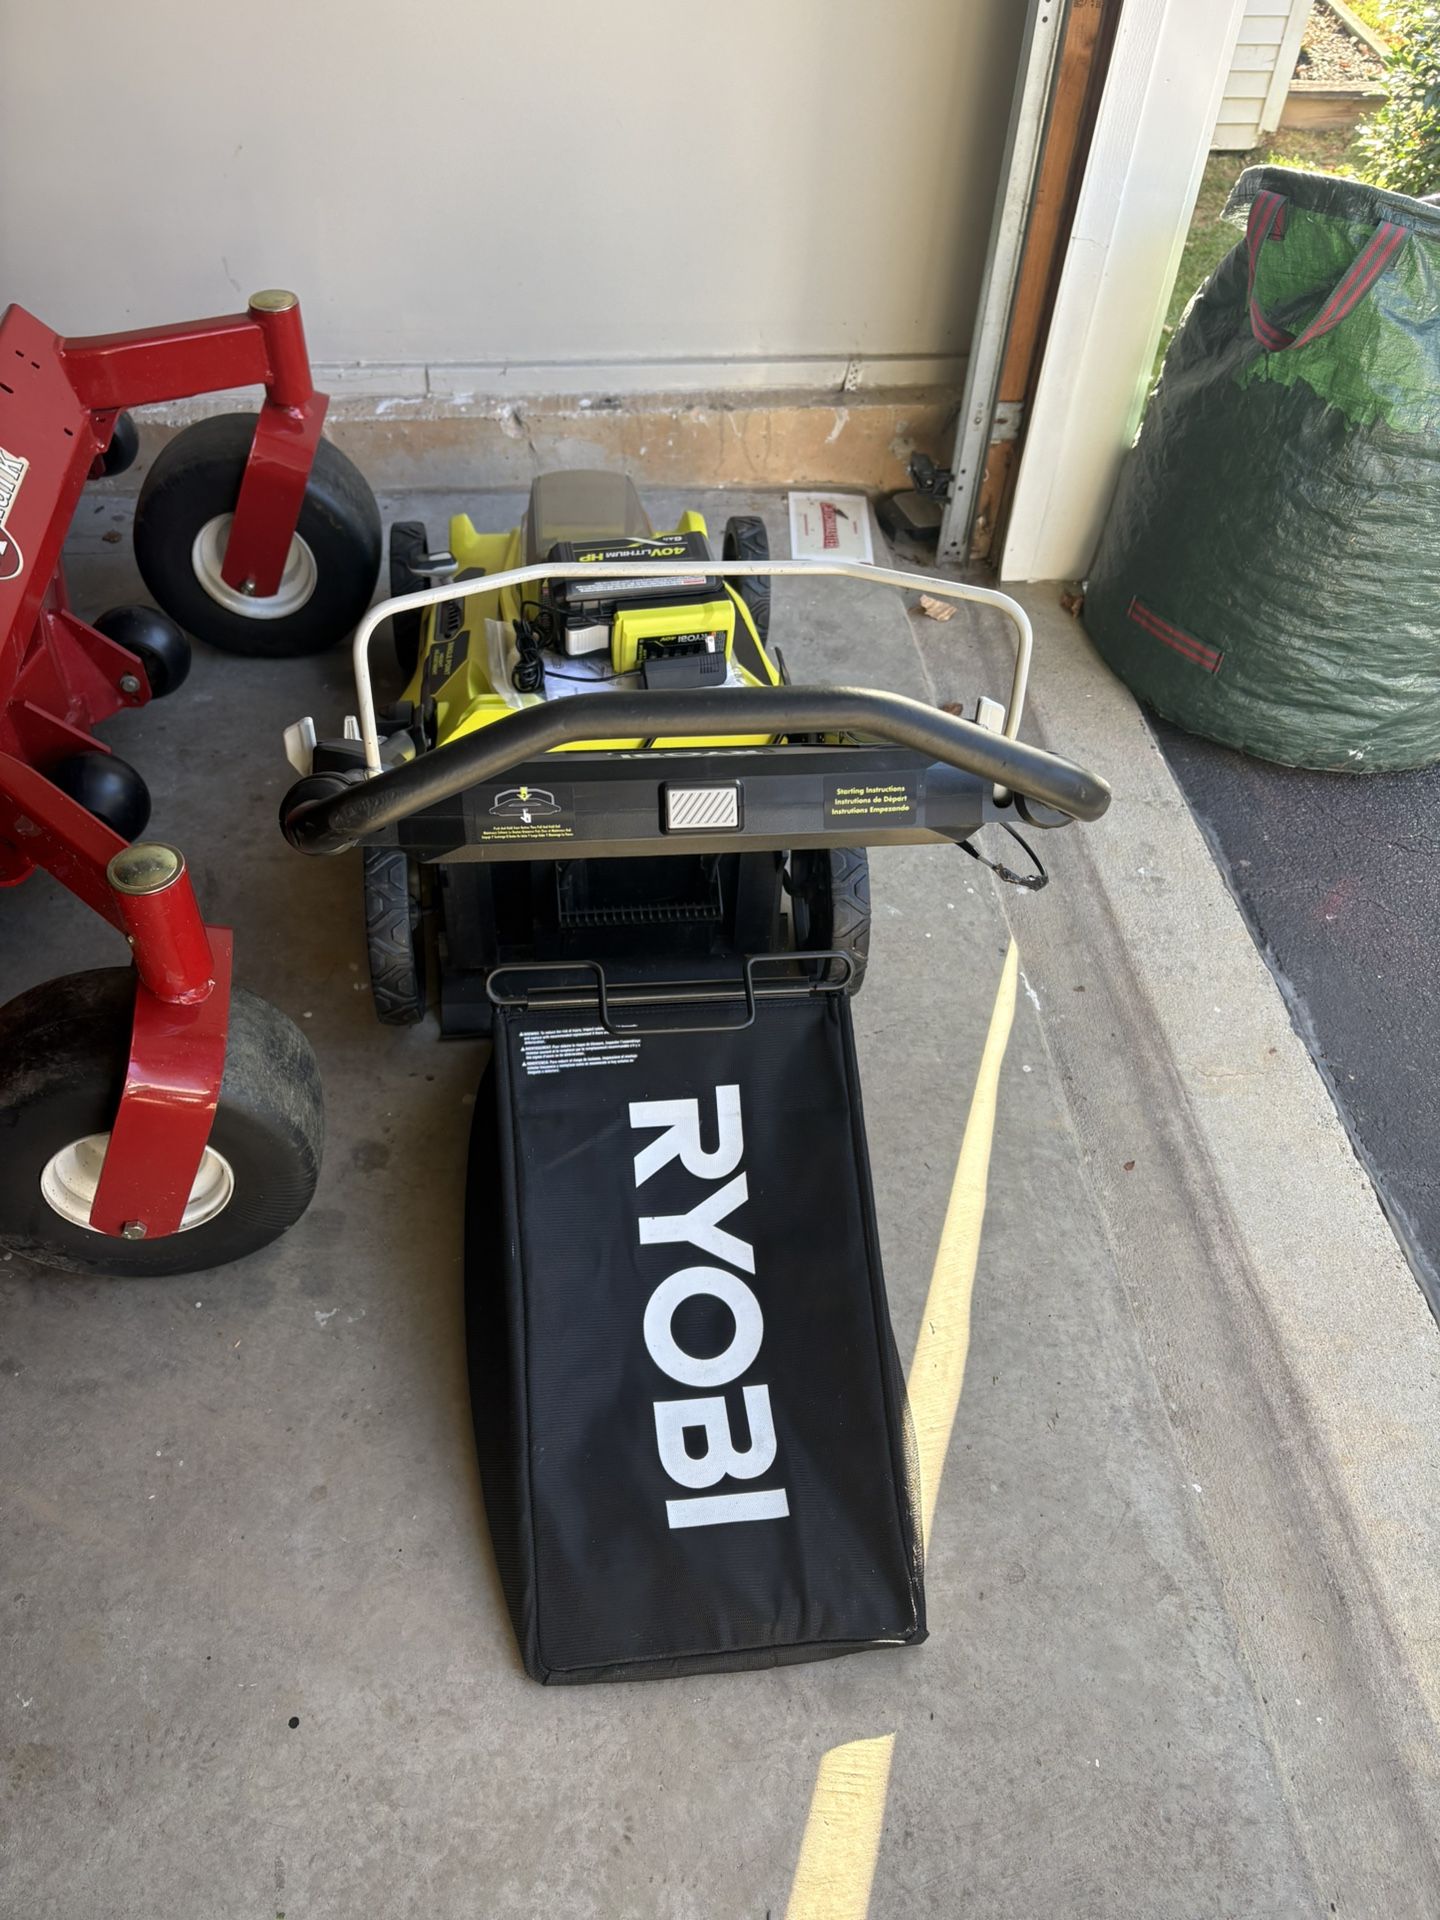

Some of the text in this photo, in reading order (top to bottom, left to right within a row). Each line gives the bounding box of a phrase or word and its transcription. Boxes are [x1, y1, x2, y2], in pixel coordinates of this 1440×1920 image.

[579, 552, 604, 563] HP
[836, 785, 906, 796] Starting Instructions
[628, 1084, 789, 1529] RYOBI
